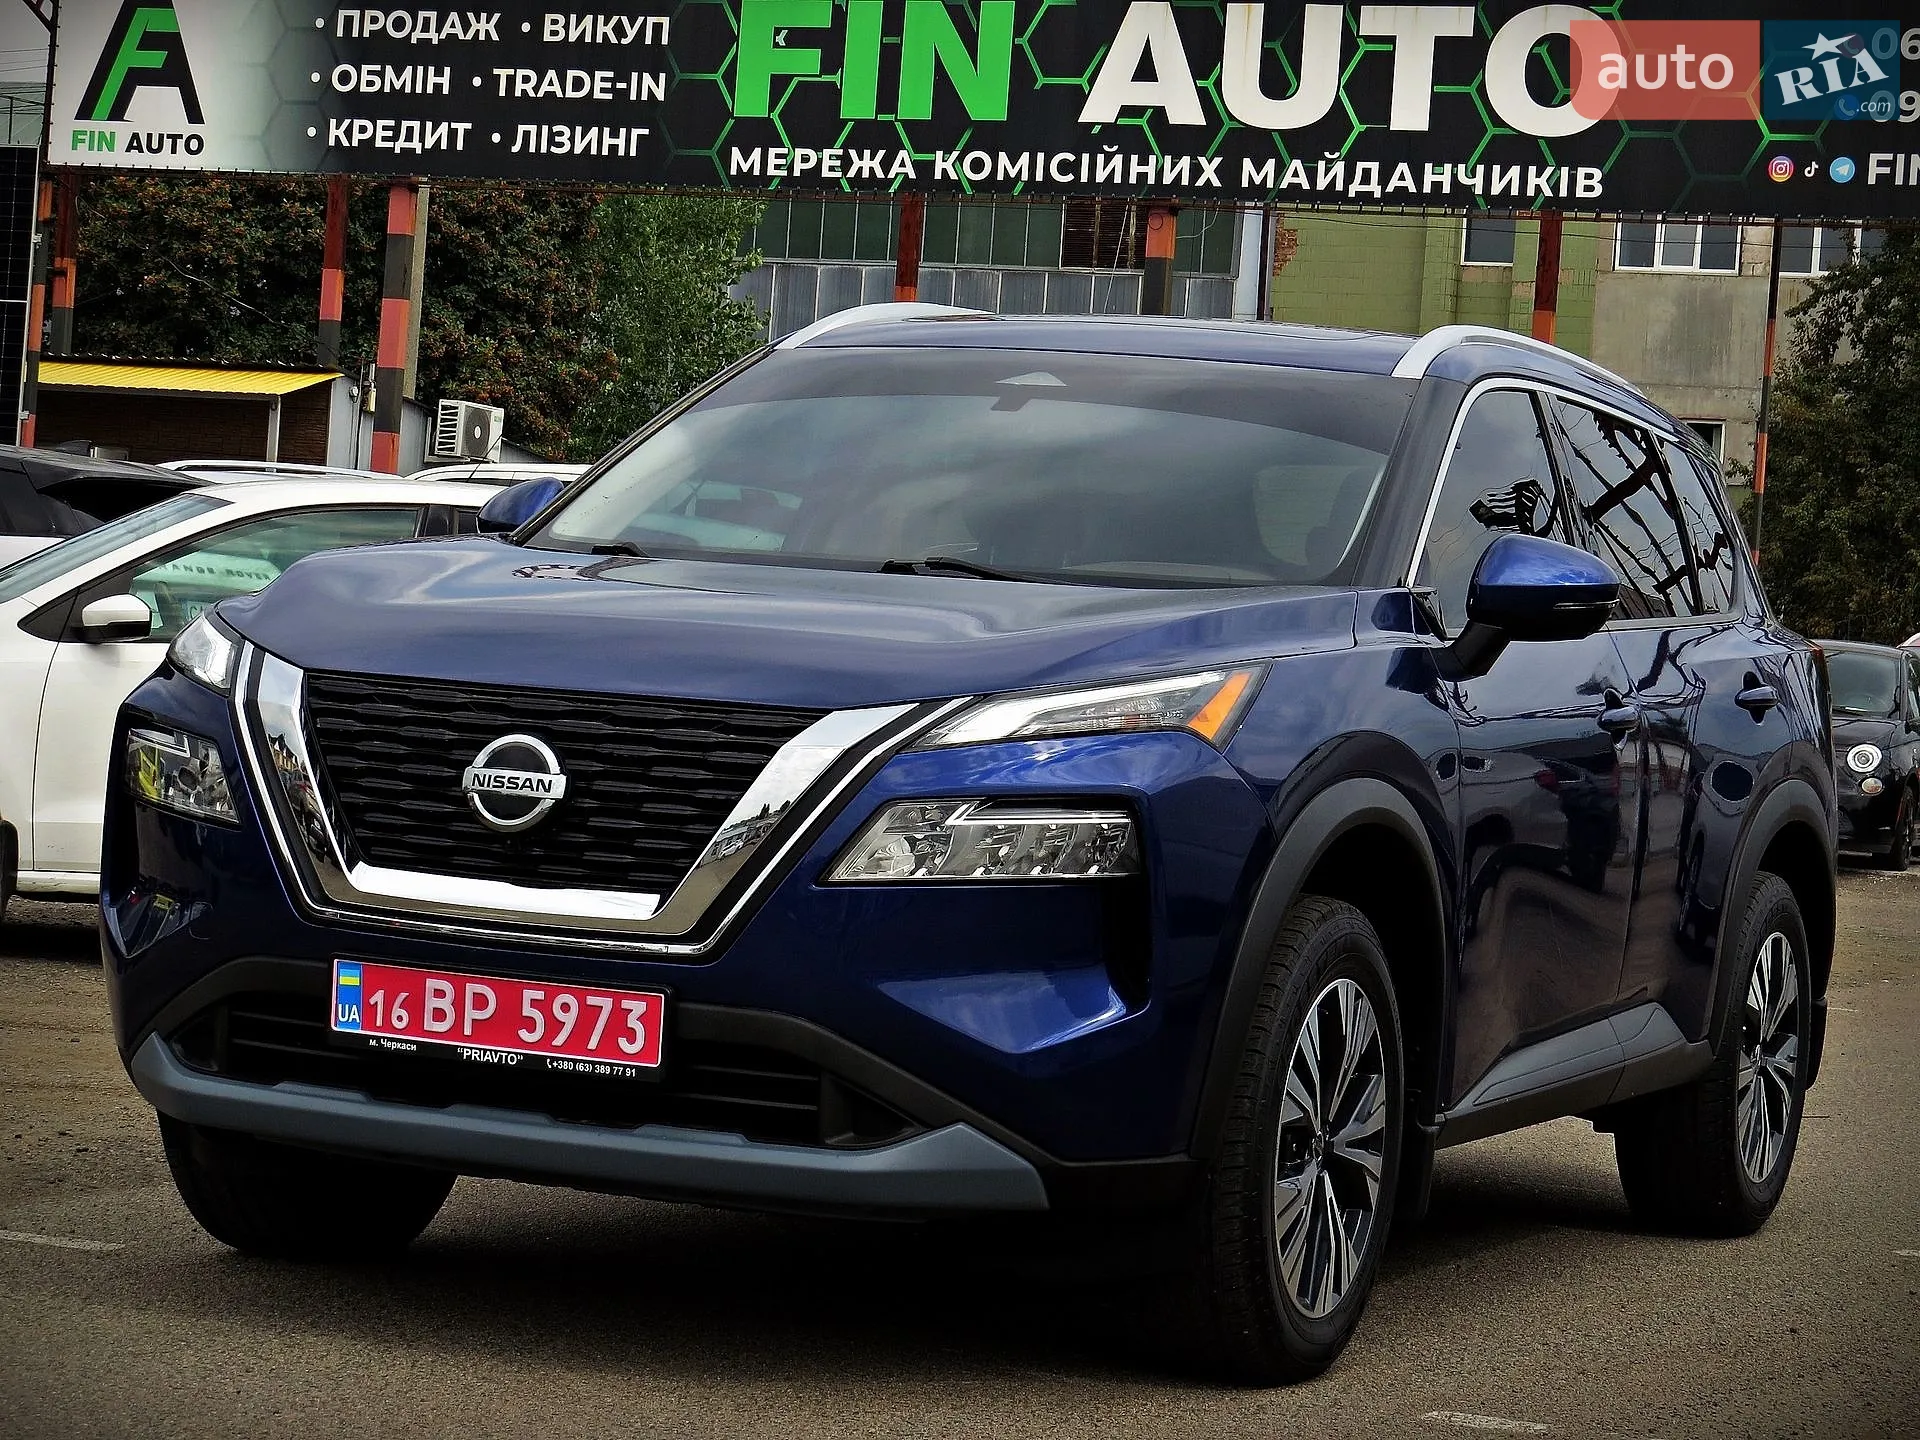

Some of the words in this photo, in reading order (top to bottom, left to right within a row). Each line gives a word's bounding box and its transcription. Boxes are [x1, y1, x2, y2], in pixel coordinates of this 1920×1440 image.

[336, 9, 501, 44] ПРОДАЖ
[543, 13, 671, 45] ВИКУП
[331, 64, 451, 95] ОБМІН
[493, 68, 667, 101] TRADE-IN
[733, 0, 1014, 121] FIN
[1077, 1, 1623, 138] AUTO
[71, 129, 116, 152] FIN
[125, 132, 205, 156] AUTO
[328, 118, 473, 155] КРЕДИТ
[511, 124, 650, 157] ЛІЗИНГ
[729, 146, 915, 180] МЕРЕЖА
[934, 145, 1222, 188] КОМІСІЙНИХ
[1241, 152, 1603, 198] МАЙДАНЧИКІВ
[471, 772, 553, 793] NISSAN
[338, 1003, 360, 1024] UA
[368, 989, 411, 1030] 16
[423, 978, 498, 1037] BP
[517, 988, 648, 1055] 5973
[552, 1061, 574, 1071] +380
[576, 1062, 593, 1073] (63)
[594, 1064, 611, 1075] 389
[613, 1066, 624, 1076] 77
[625, 1067, 636, 1078] 91
